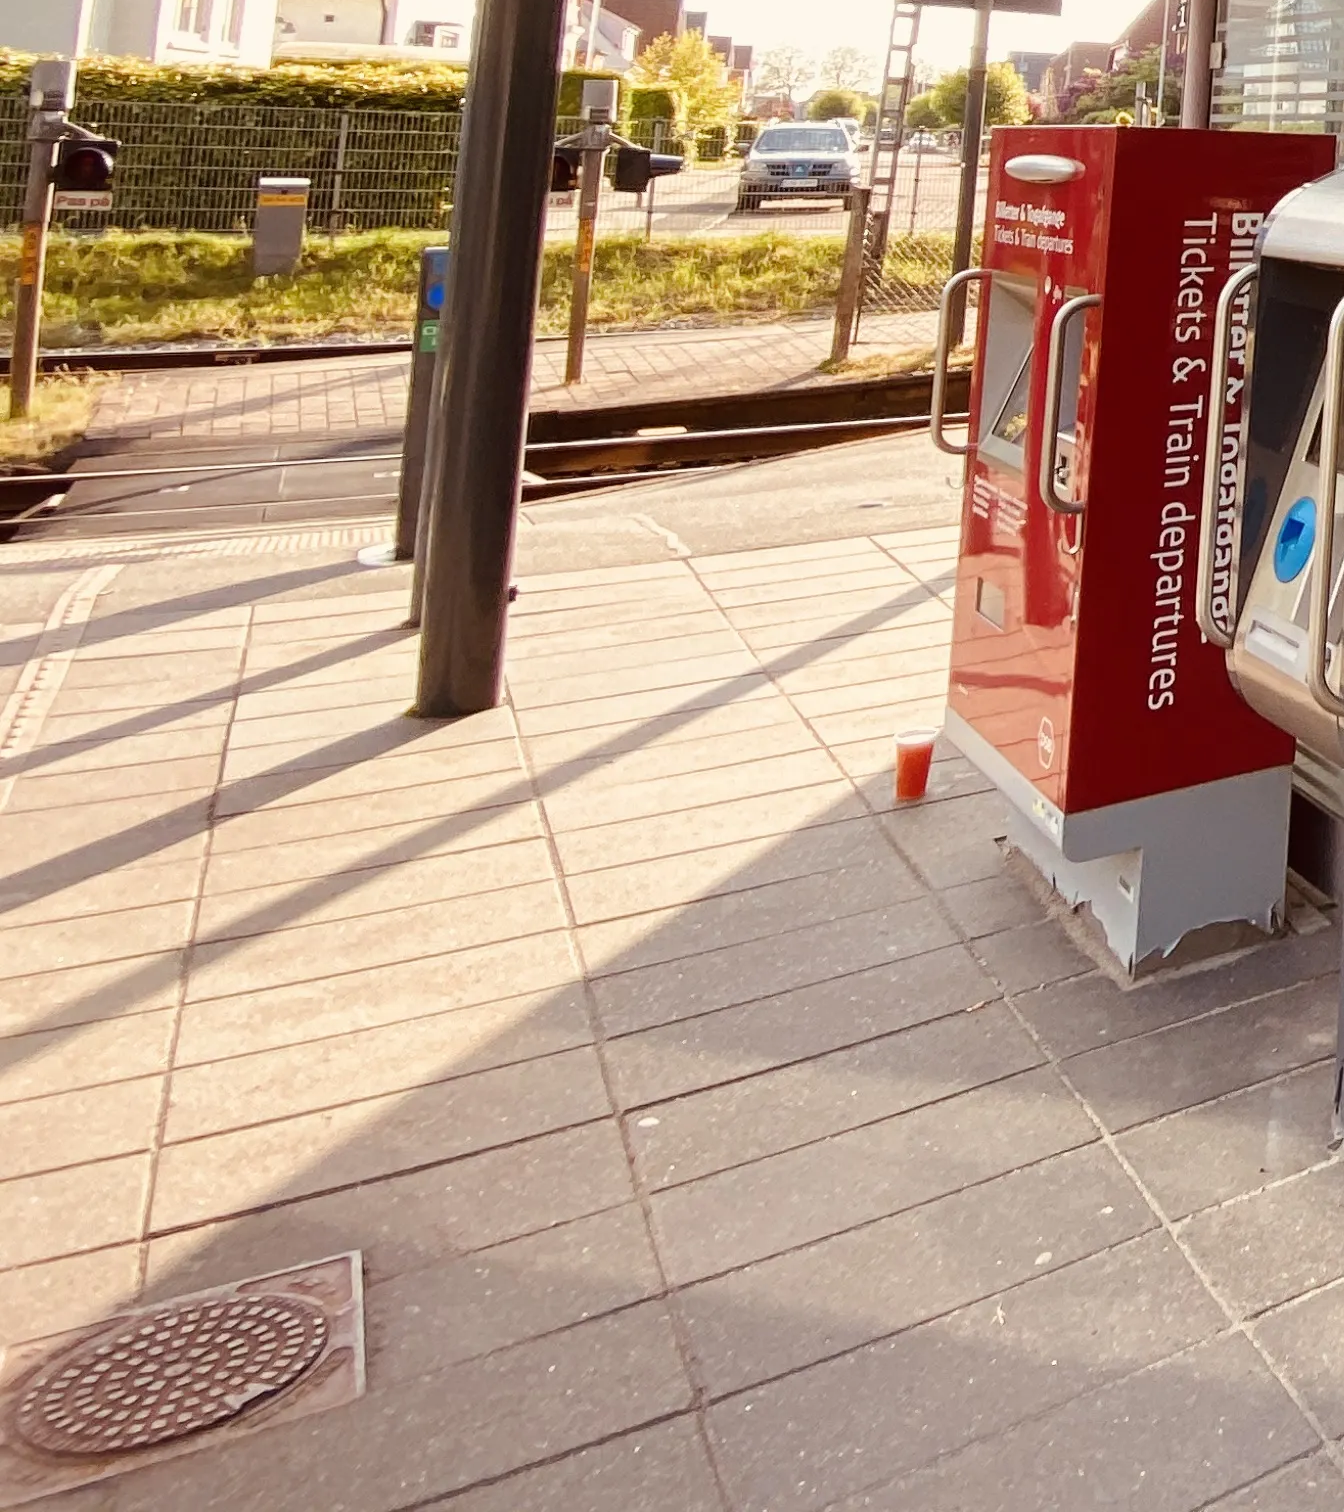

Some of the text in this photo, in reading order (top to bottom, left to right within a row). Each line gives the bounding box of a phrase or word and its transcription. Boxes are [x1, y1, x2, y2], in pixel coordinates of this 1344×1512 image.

[1147, 212, 1218, 711] Tickets & Train departures
